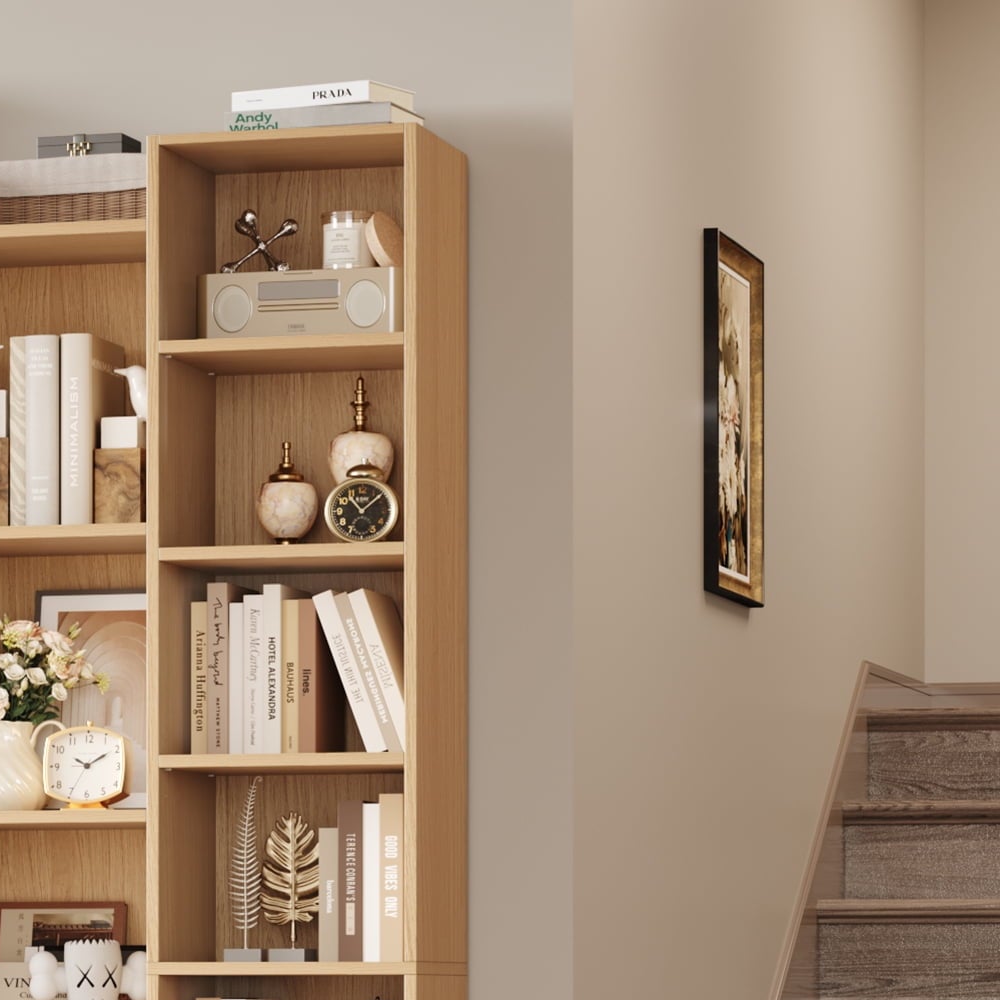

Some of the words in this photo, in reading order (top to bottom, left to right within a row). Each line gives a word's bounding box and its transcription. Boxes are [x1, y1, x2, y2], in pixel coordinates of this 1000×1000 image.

[312, 88, 352, 100] PRADA
[235, 112, 272, 125] Andy
[69, 376, 80, 488] MINIMALISM
[338, 497, 348, 505] 10
[339, 518, 346, 526] 8
[213, 597, 223, 620] The
[250, 608, 260, 633] Karen
[195, 630, 206, 672] Arianna
[247, 636, 260, 682] McCartney
[268, 636, 276, 665] HOTEL
[286, 662, 294, 704] BAUHAUS
[301, 668, 311, 696] lines.
[268, 667, 276, 721] ALEXANDRA
[193, 675, 206, 732] Huffington
[68, 737, 76, 745] 11
[85, 734, 94, 744] 12
[56, 745, 65, 754] 10
[114, 745, 120, 753] 2
[54, 763, 60, 772] 9
[115, 762, 121, 770] 3
[56, 781, 62, 789] 8
[68, 787, 74, 796] 7
[100, 787, 106, 795] 5
[112, 780, 118, 789] 4
[83, 790, 90, 798] 6
[346, 833, 356, 866] TERENCE
[384, 835, 398, 858] GOOD
[346, 867, 356, 902] CONRAN'S
[384, 865, 398, 890] VIBES
[384, 896, 398, 918] ONLY
